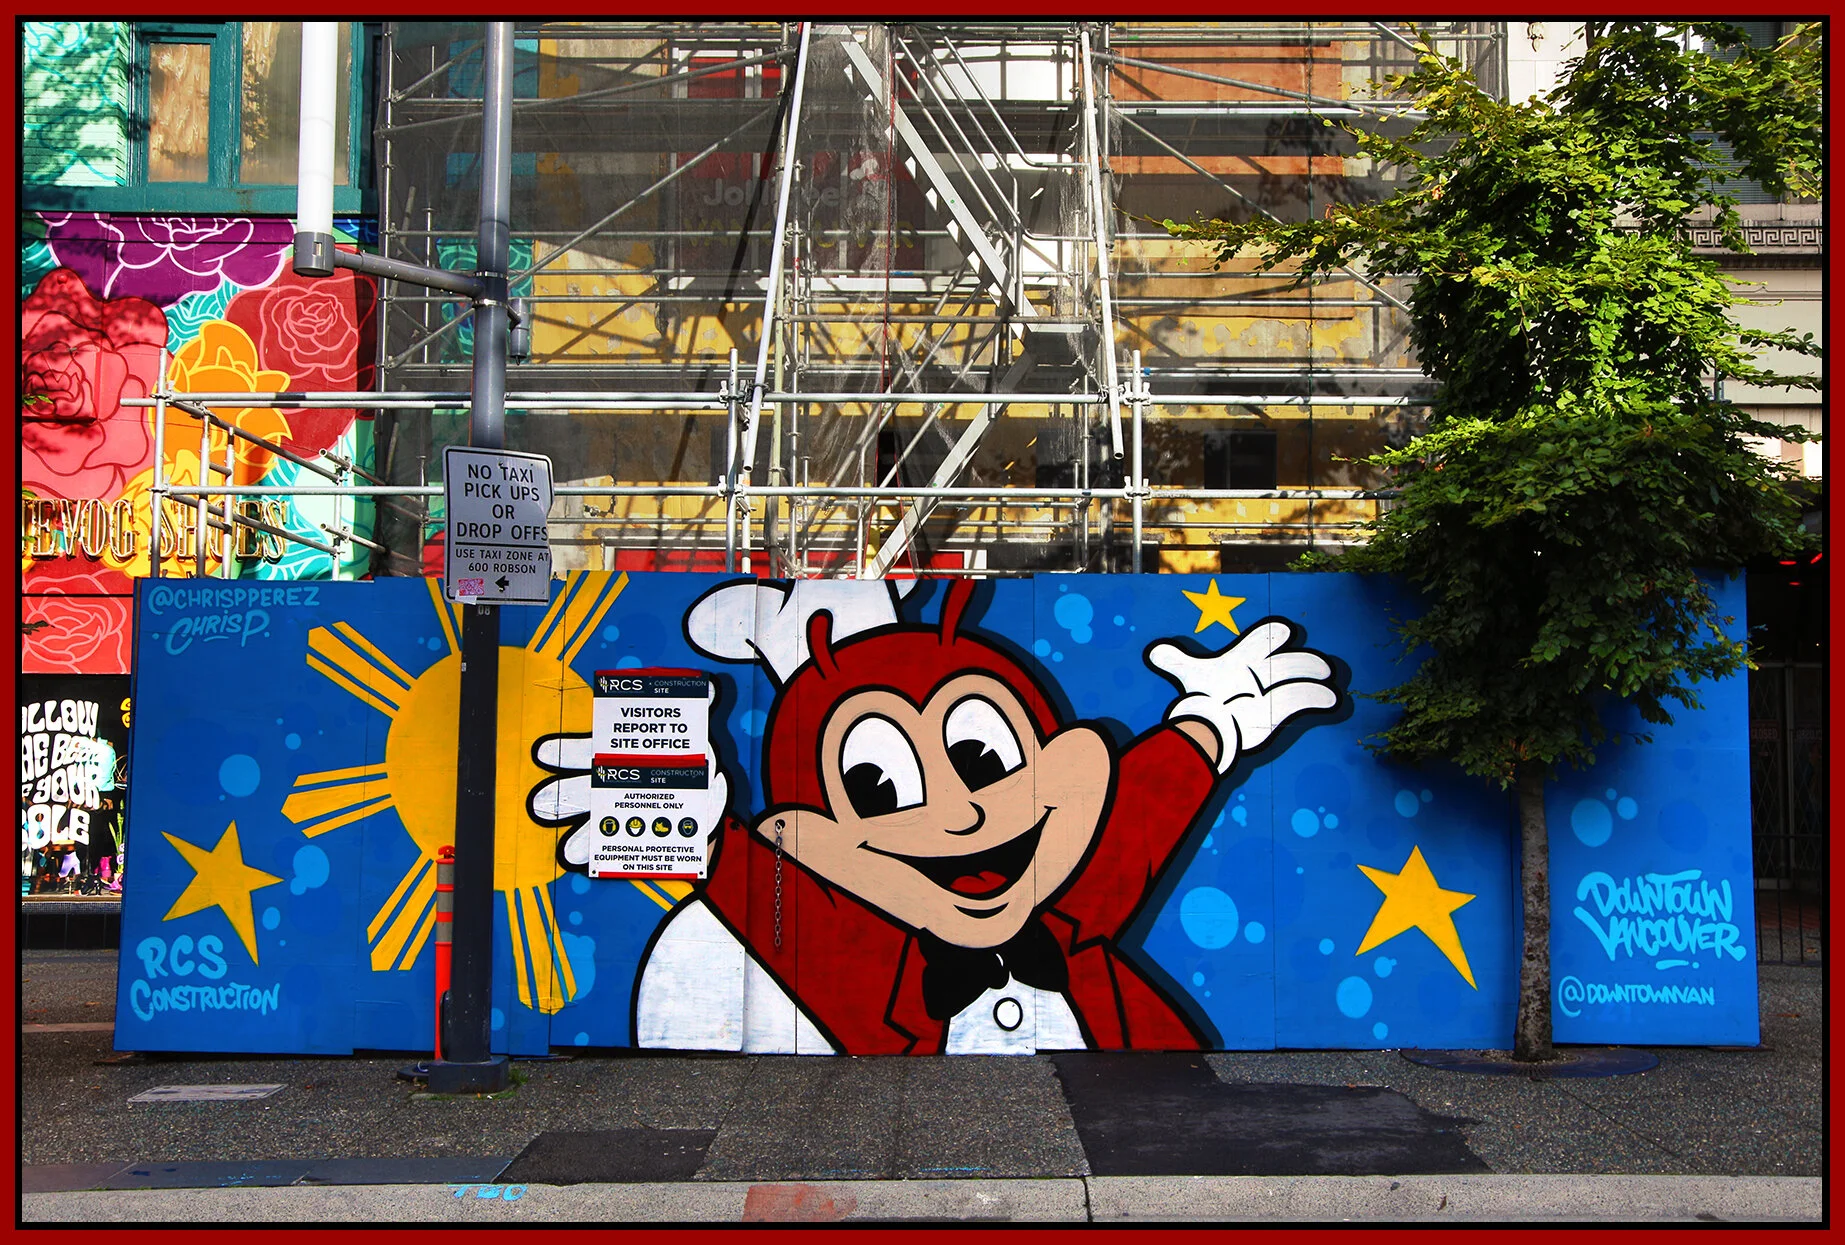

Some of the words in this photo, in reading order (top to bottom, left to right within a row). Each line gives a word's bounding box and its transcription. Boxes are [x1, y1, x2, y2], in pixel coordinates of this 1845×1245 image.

[703, 178, 841, 207] Jolliee
[468, 464, 492, 480] NO
[501, 466, 534, 483] TAXI
[464, 482, 501, 499] PICK
[510, 485, 540, 502] UPS
[492, 503, 515, 520] OR
[22, 498, 138, 563] EVOG
[456, 522, 502, 539] DROP
[511, 525, 548, 541] OFFS
[455, 549, 475, 559] USE
[479, 549, 502, 560] TAXI
[506, 550, 533, 561] ZONE
[537, 551, 549, 562] AT
[468, 562, 489, 573] 600
[493, 563, 536, 574] ROBSON
[149, 585, 320, 615] @CHRISPPEREZ
[609, 679, 643, 691] RCS
[621, 707, 681, 718] VISITORS
[613, 723, 667, 733] REPORT
[669, 723, 688, 734] TO
[610, 738, 639, 749] SITE
[642, 738, 690, 749] OFFICE
[607, 769, 640, 780] RCS
[594, 854, 639, 862] EQUIPMENT
[602, 845, 644, 853] PERSONAL
[1576, 869, 1733, 922] DOWNTOWN
[1573, 906, 1747, 962] VANCOUVER
[136, 934, 228, 980] RCS
[130, 978, 280, 1021] CONSTRUCTION
